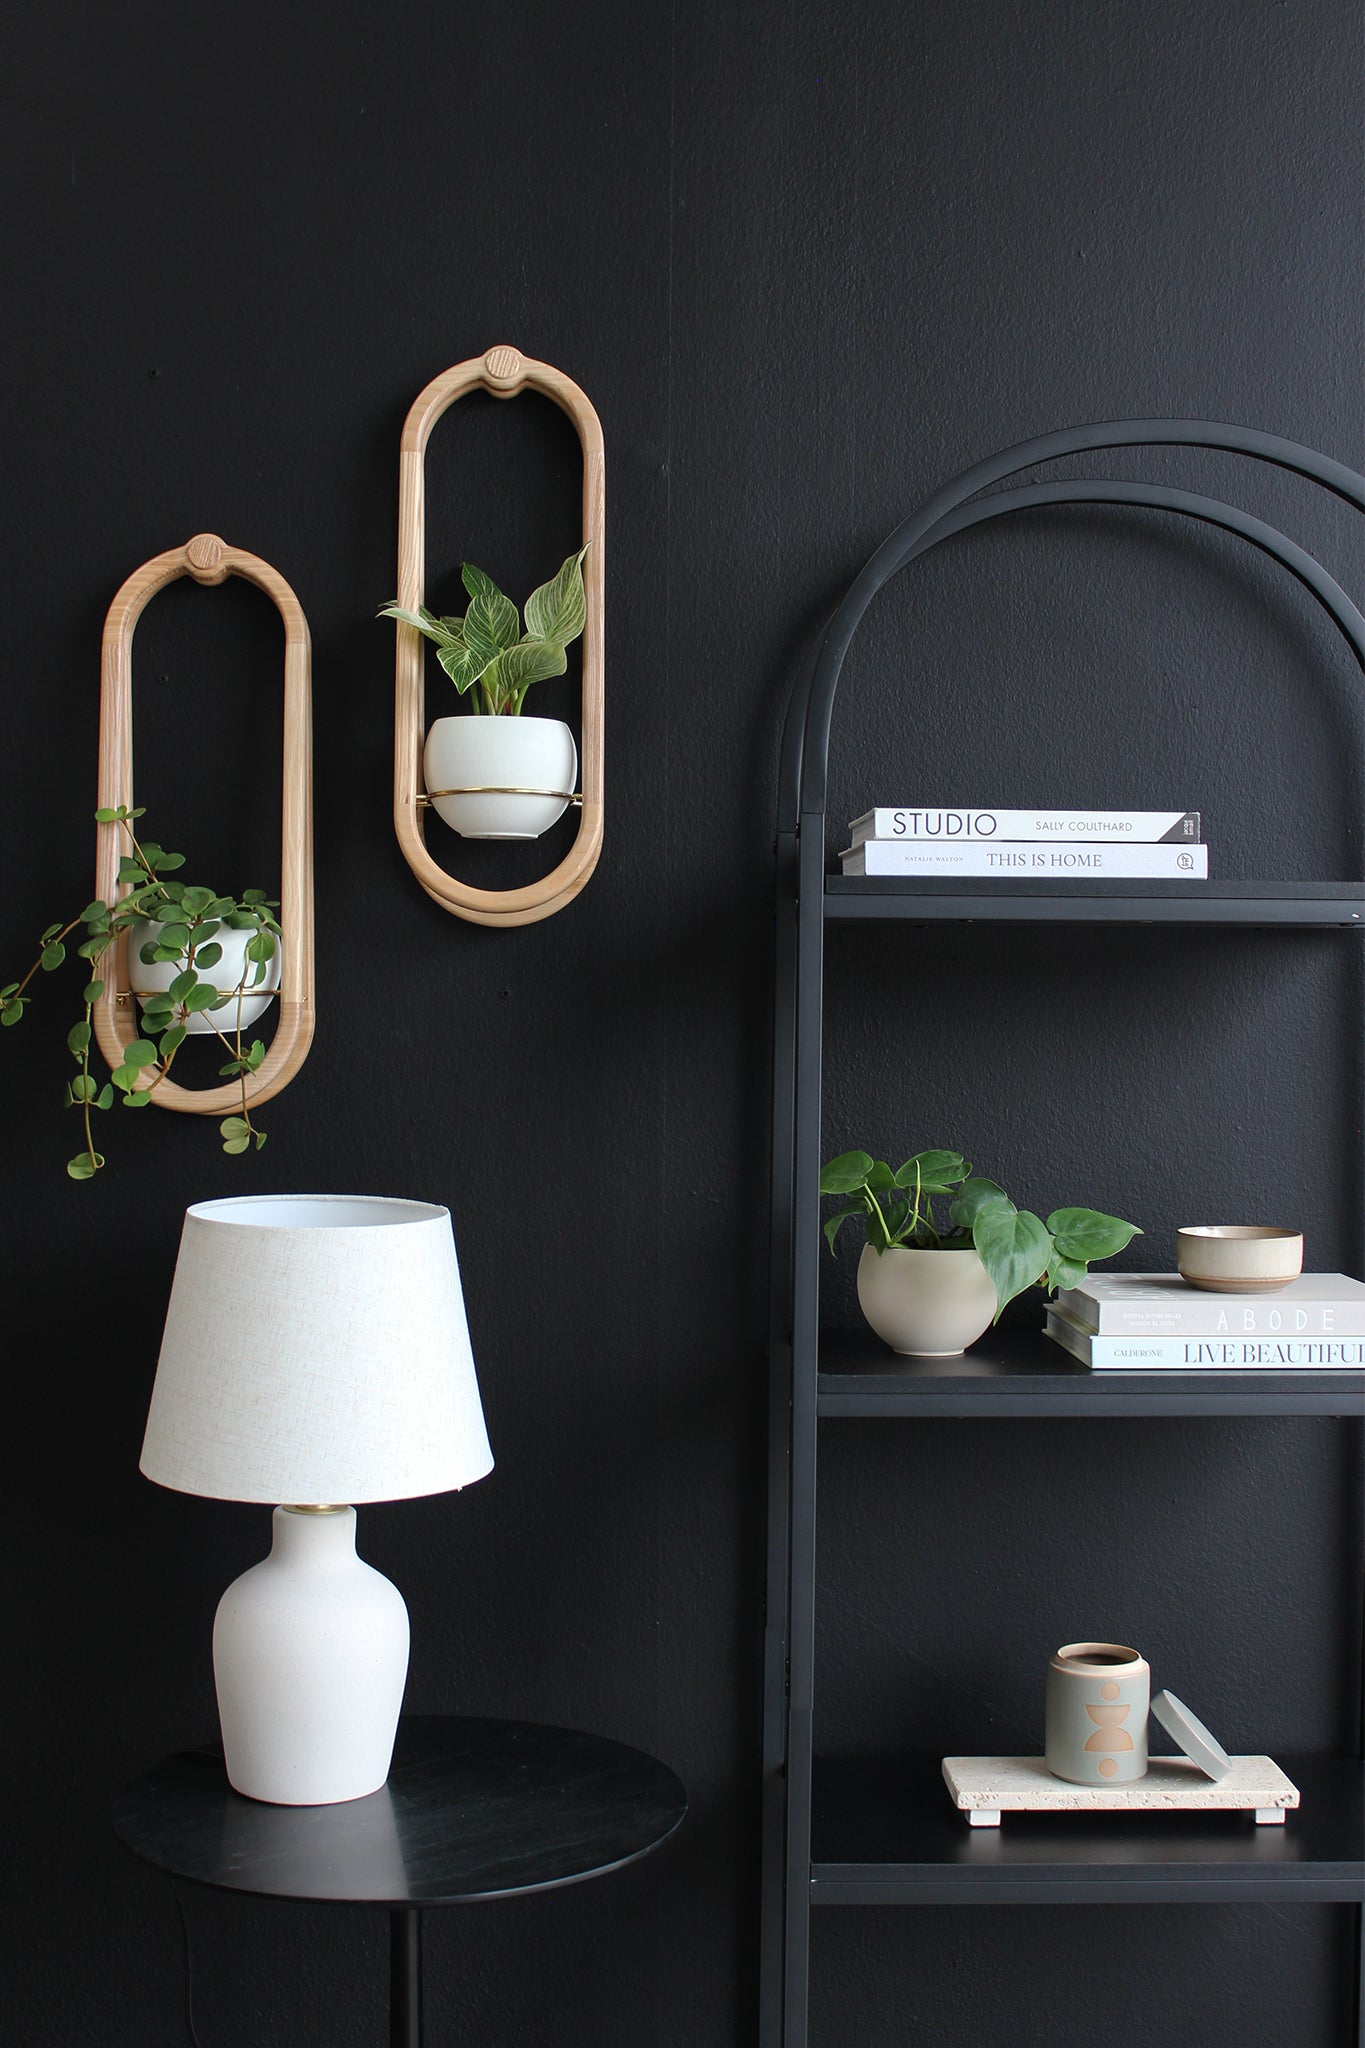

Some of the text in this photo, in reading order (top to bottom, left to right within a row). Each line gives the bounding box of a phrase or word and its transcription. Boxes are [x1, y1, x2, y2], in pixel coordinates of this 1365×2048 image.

[893, 812, 997, 836] STUDIO
[1035, 820, 1133, 832] SALLY COULTHARD
[987, 853, 1102, 867] THIS IS HOME
[1216, 1308, 1335, 1331] ABODE
[1113, 1349, 1164, 1358] CALDERONE
[1184, 1343, 1235, 1363] LIVE
